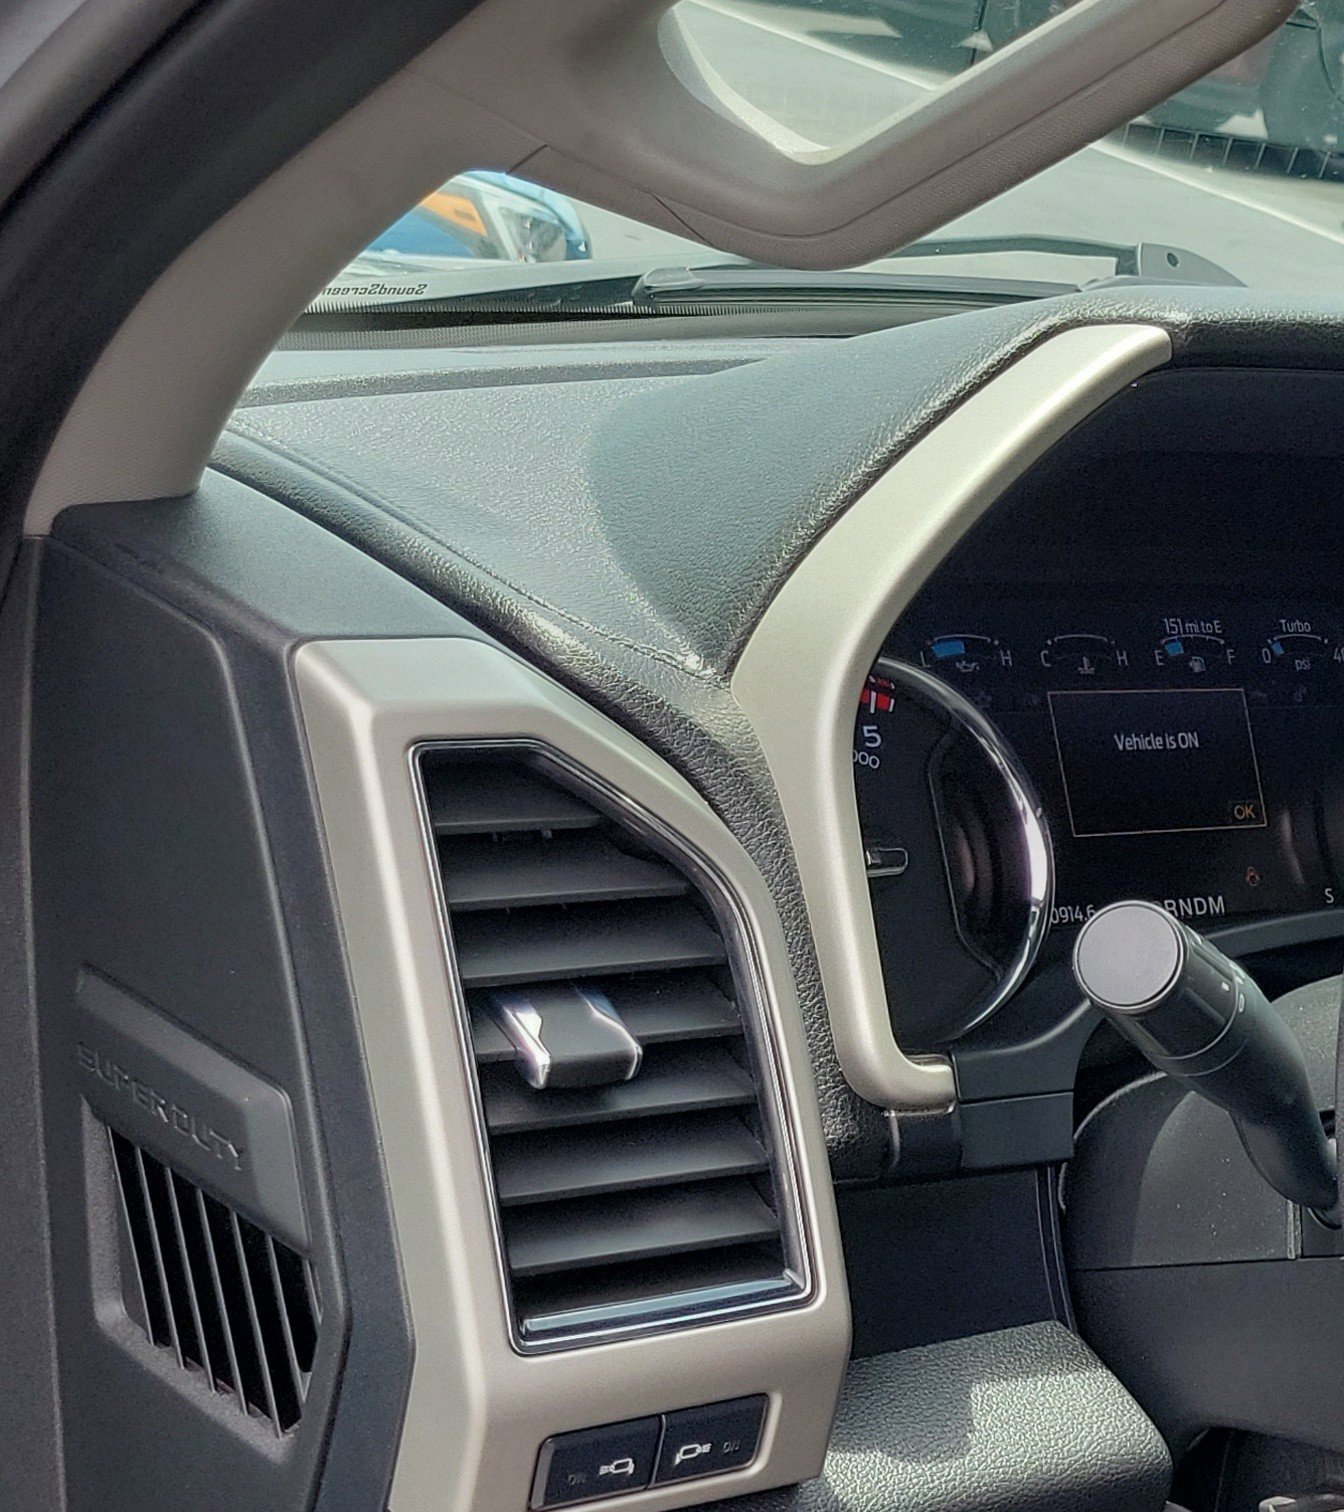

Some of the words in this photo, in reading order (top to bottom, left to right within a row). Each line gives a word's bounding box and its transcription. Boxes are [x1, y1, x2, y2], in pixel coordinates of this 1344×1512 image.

[1163, 618, 1183, 635] 151
[1185, 620, 1199, 634] mi
[1201, 620, 1212, 634] to
[1213, 620, 1223, 634] E
[1279, 619, 1311, 633] Turbo
[920, 651, 931, 668] L
[1000, 650, 1013, 667] H
[1040, 650, 1052, 667] C
[1116, 650, 1128, 666] H
[1155, 650, 1165, 666] E
[1226, 650, 1235, 665] F
[1295, 659, 1312, 672] psi
[863, 725, 882, 748] 5
[1114, 733, 1163, 751] Vehicle
[1165, 733, 1177, 749] is
[1178, 732, 1200, 749] ON
[1234, 804, 1256, 820] OK
[1325, 888, 1335, 904] S
[1156, 895, 1225, 918] RNDM
